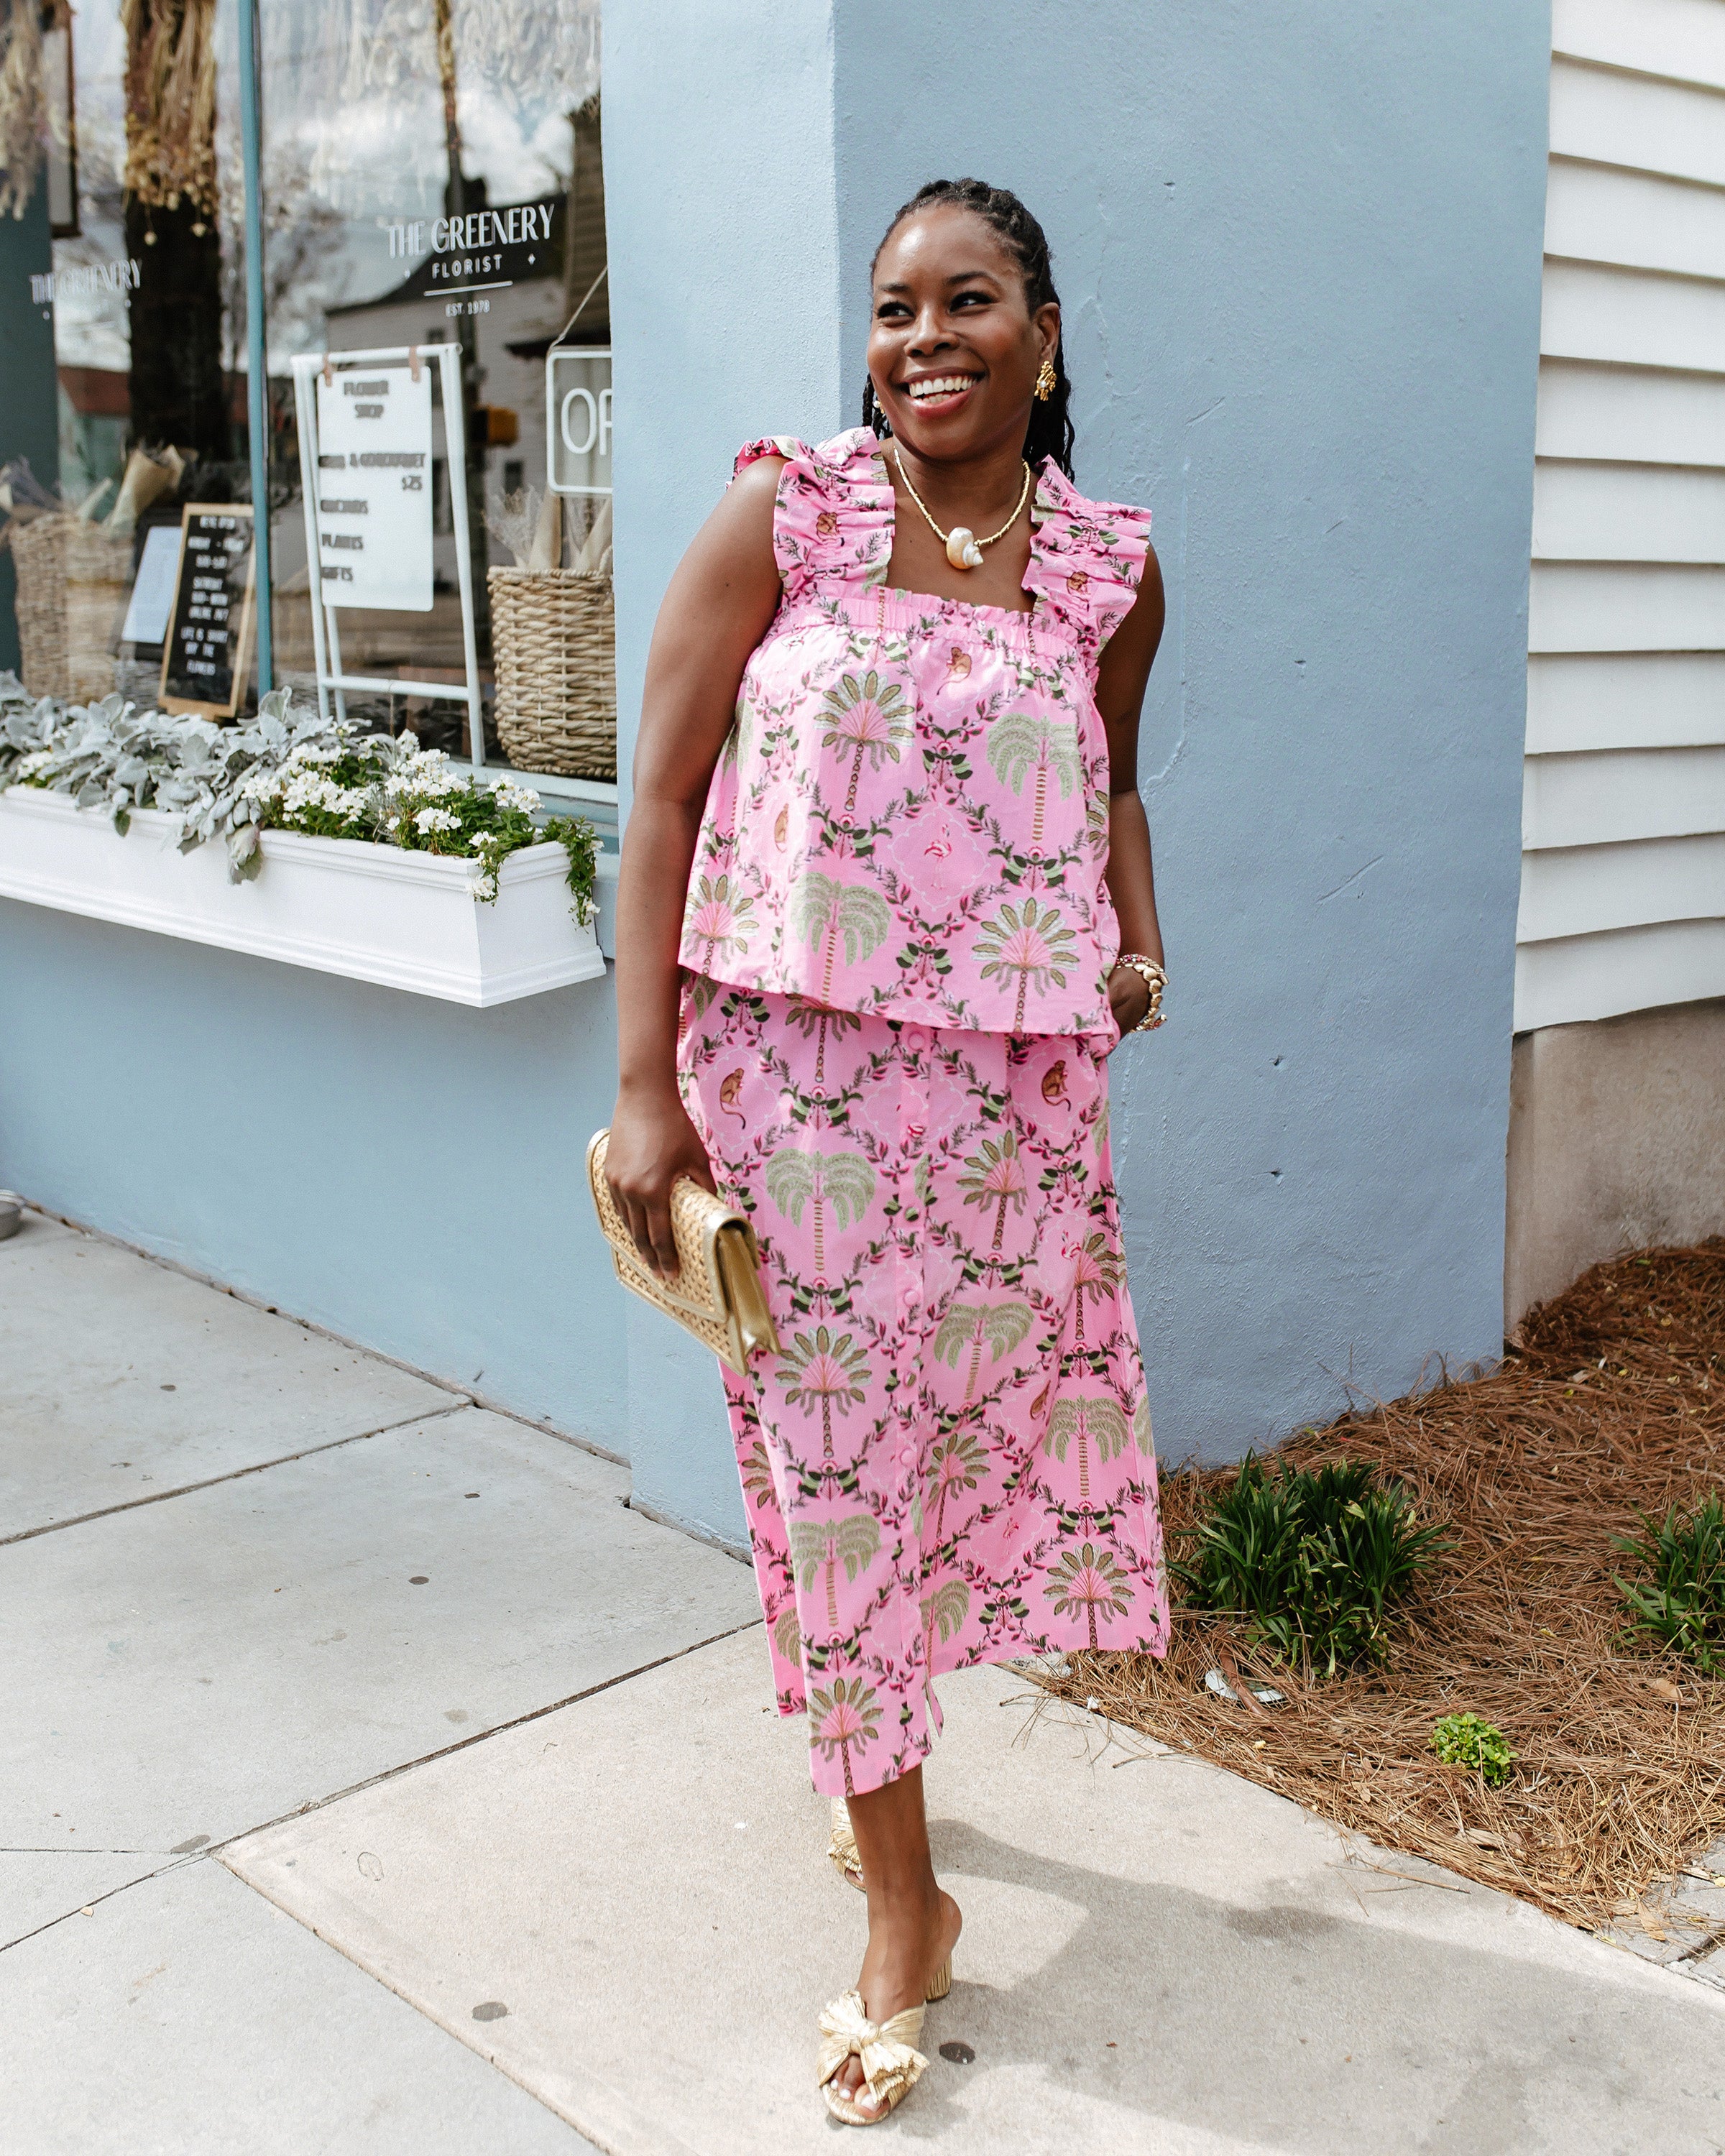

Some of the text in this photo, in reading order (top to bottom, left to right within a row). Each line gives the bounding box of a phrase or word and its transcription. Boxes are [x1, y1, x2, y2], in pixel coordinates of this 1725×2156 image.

[387, 203, 554, 259] THE GREENERY
[432, 254, 502, 280] FLORIST
